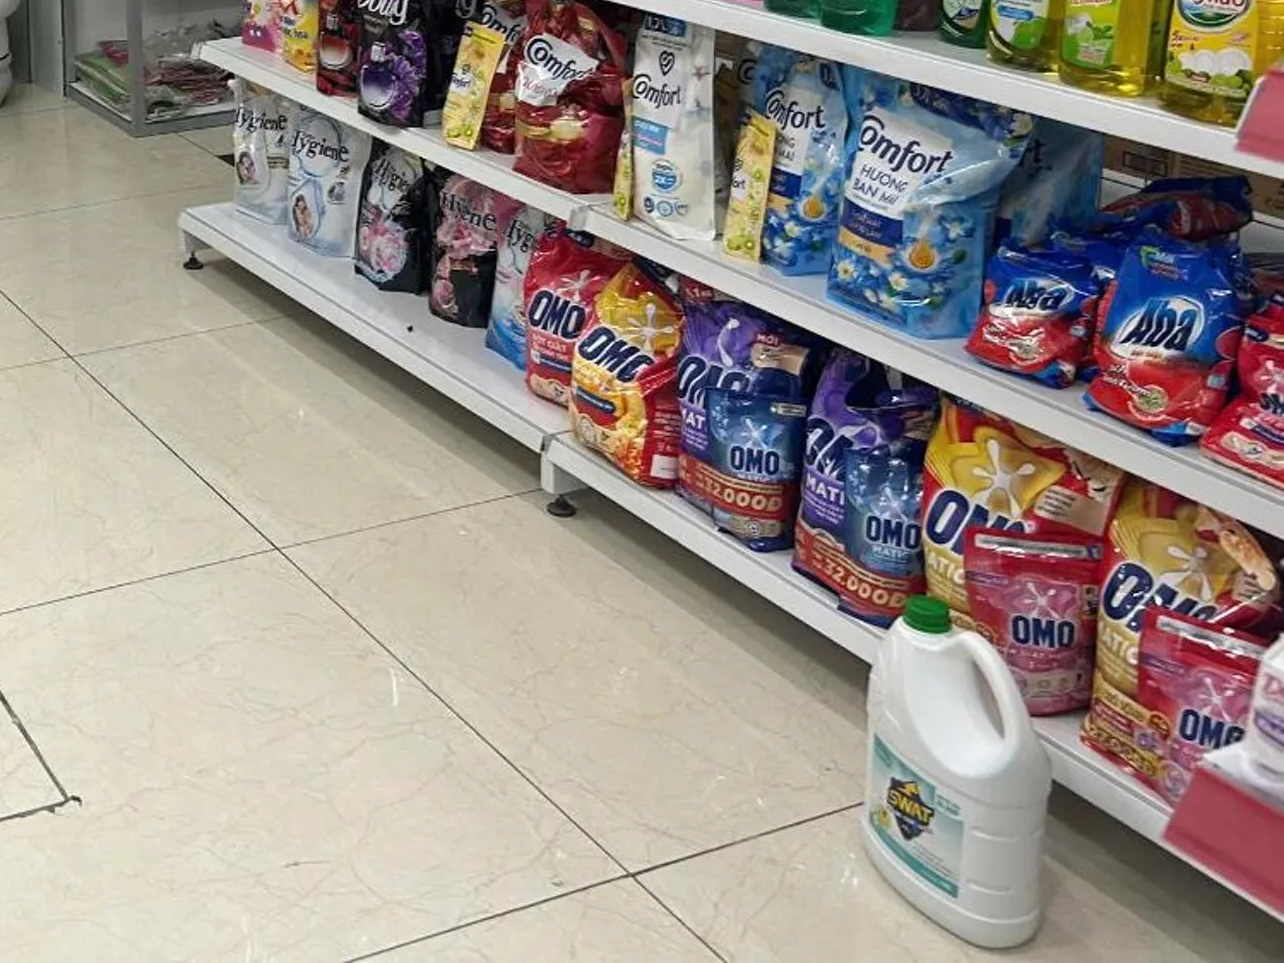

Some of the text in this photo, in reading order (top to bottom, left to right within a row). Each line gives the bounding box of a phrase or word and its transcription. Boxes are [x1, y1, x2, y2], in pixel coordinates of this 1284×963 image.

[632, 73, 682, 110] Comfort
[859, 114, 954, 176] Comfort
[527, 288, 587, 341] OMO
[1118, 296, 1198, 352] Aba
[577, 325, 656, 384] OMO
[729, 444, 780, 476] OMO
[805, 474, 845, 506] MATI
[866, 515, 922, 549] OMO
[927, 551, 965, 584] ATIC
[1012, 614, 1075, 649] OMO
[1179, 708, 1245, 750] OMO
[886, 789, 935, 826] SWAT
